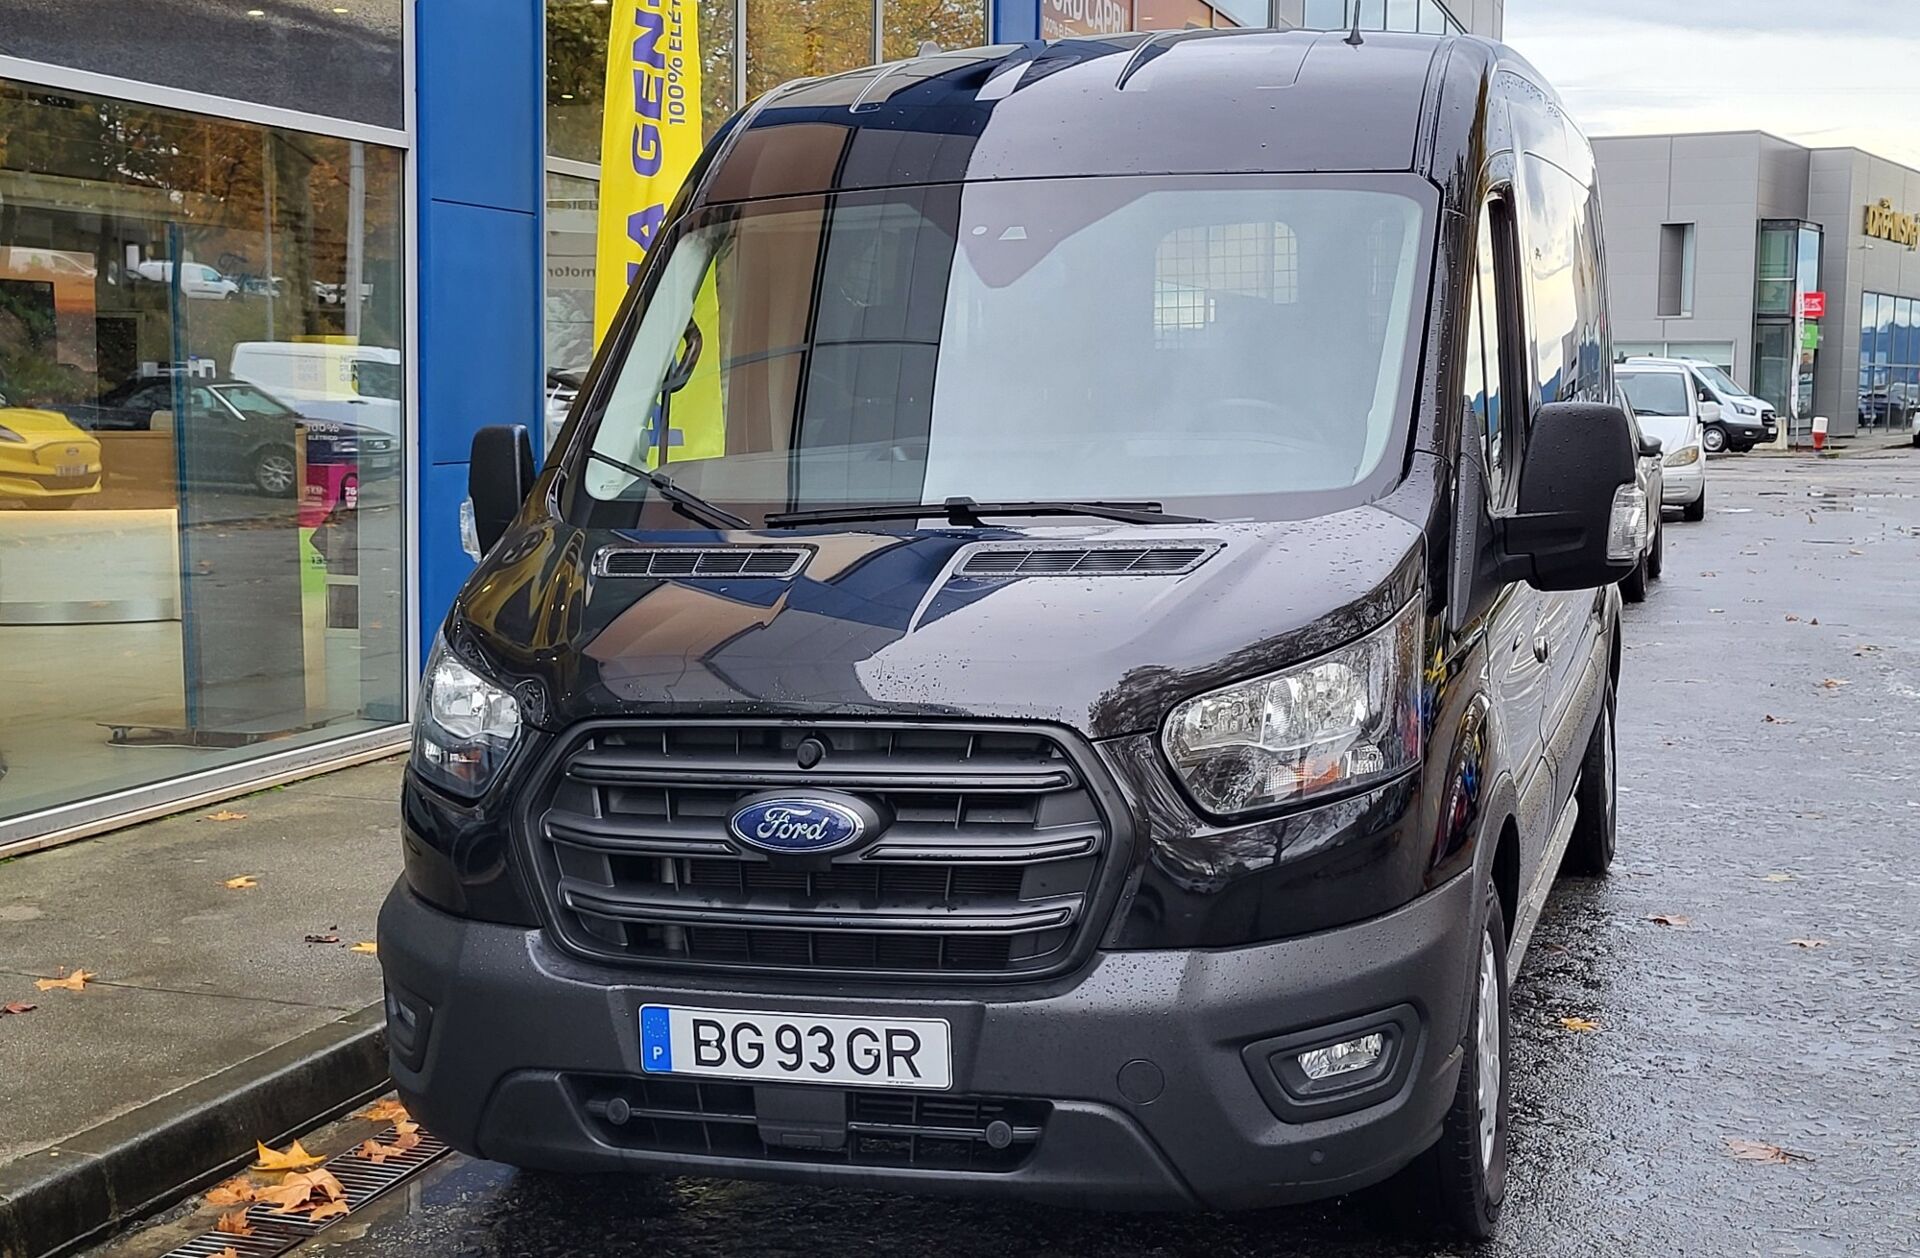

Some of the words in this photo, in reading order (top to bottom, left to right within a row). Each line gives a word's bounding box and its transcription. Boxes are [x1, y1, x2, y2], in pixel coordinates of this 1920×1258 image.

[1043, 0, 1083, 21] RD
[668, 57, 685, 125] 100%
[757, 807, 829, 839] Ford
[653, 1046, 663, 1060] P
[692, 1018, 765, 1069] BG
[775, 1024, 836, 1073] 93
[846, 1027, 922, 1079] GR
